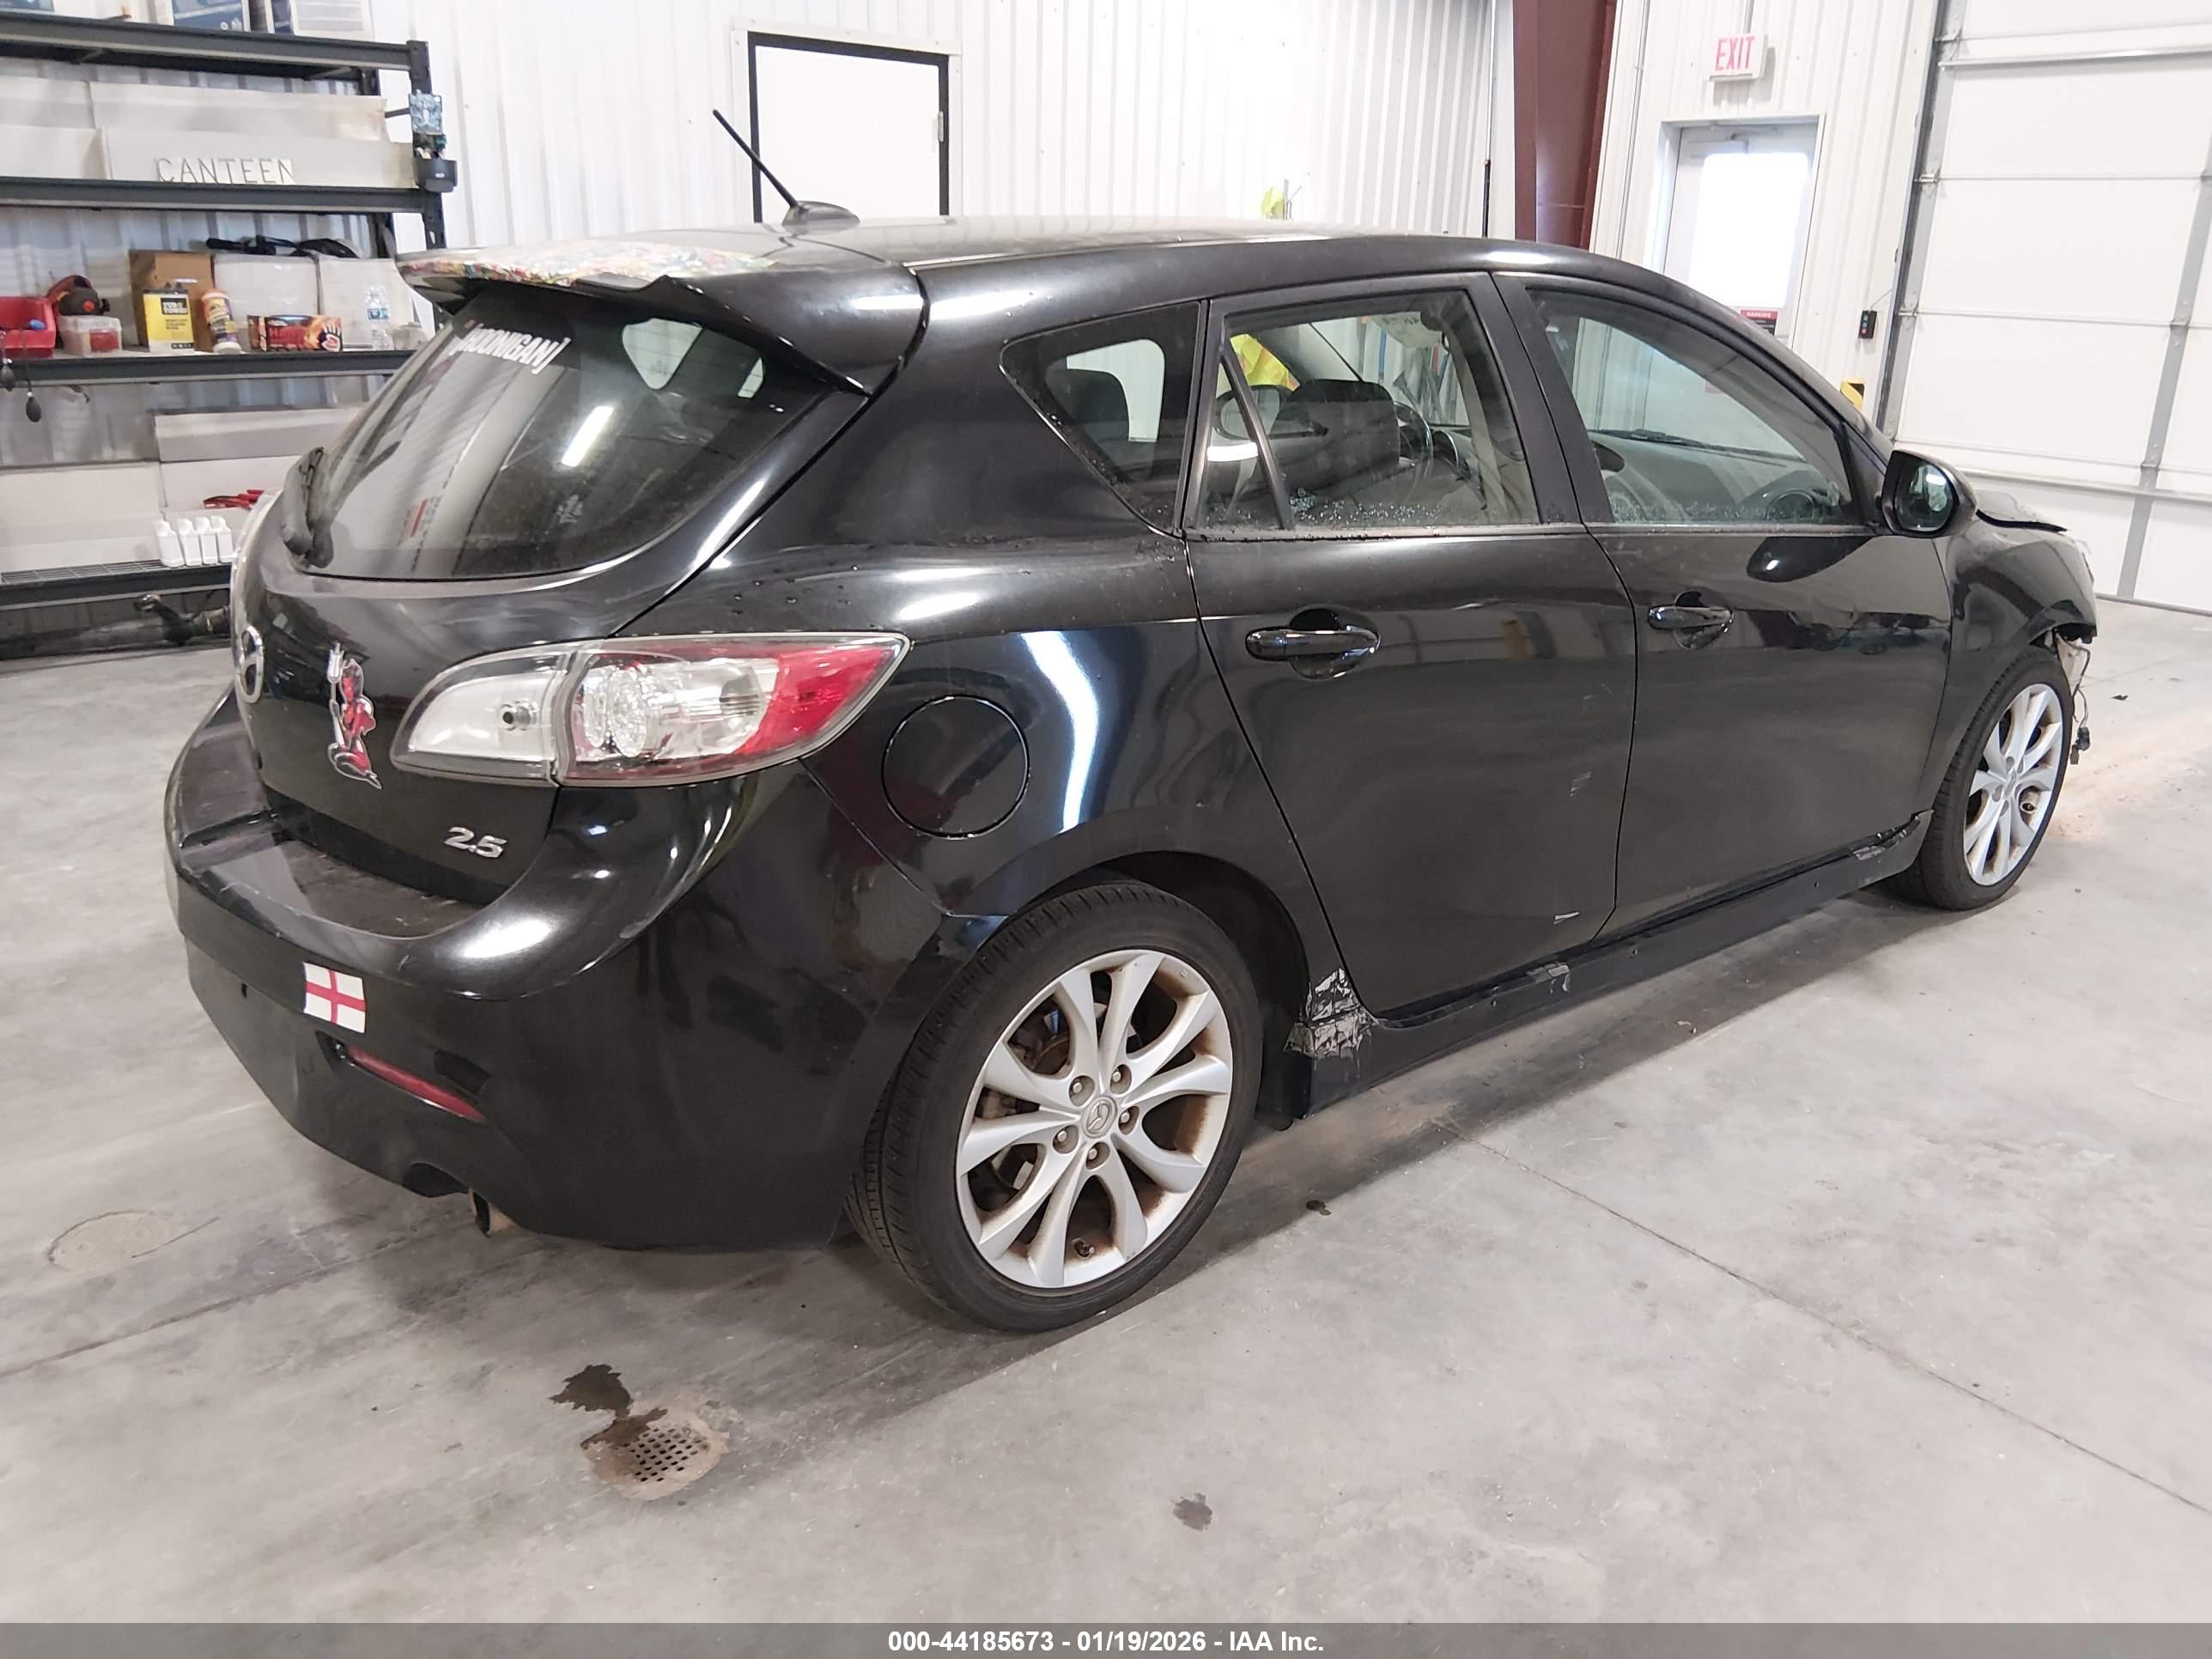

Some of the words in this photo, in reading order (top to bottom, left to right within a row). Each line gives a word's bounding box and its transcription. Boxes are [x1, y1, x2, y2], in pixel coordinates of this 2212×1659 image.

[1715, 36, 1755, 71] EXIT
[155, 158, 296, 184] CANTEEN
[443, 826, 507, 859] 2.5
